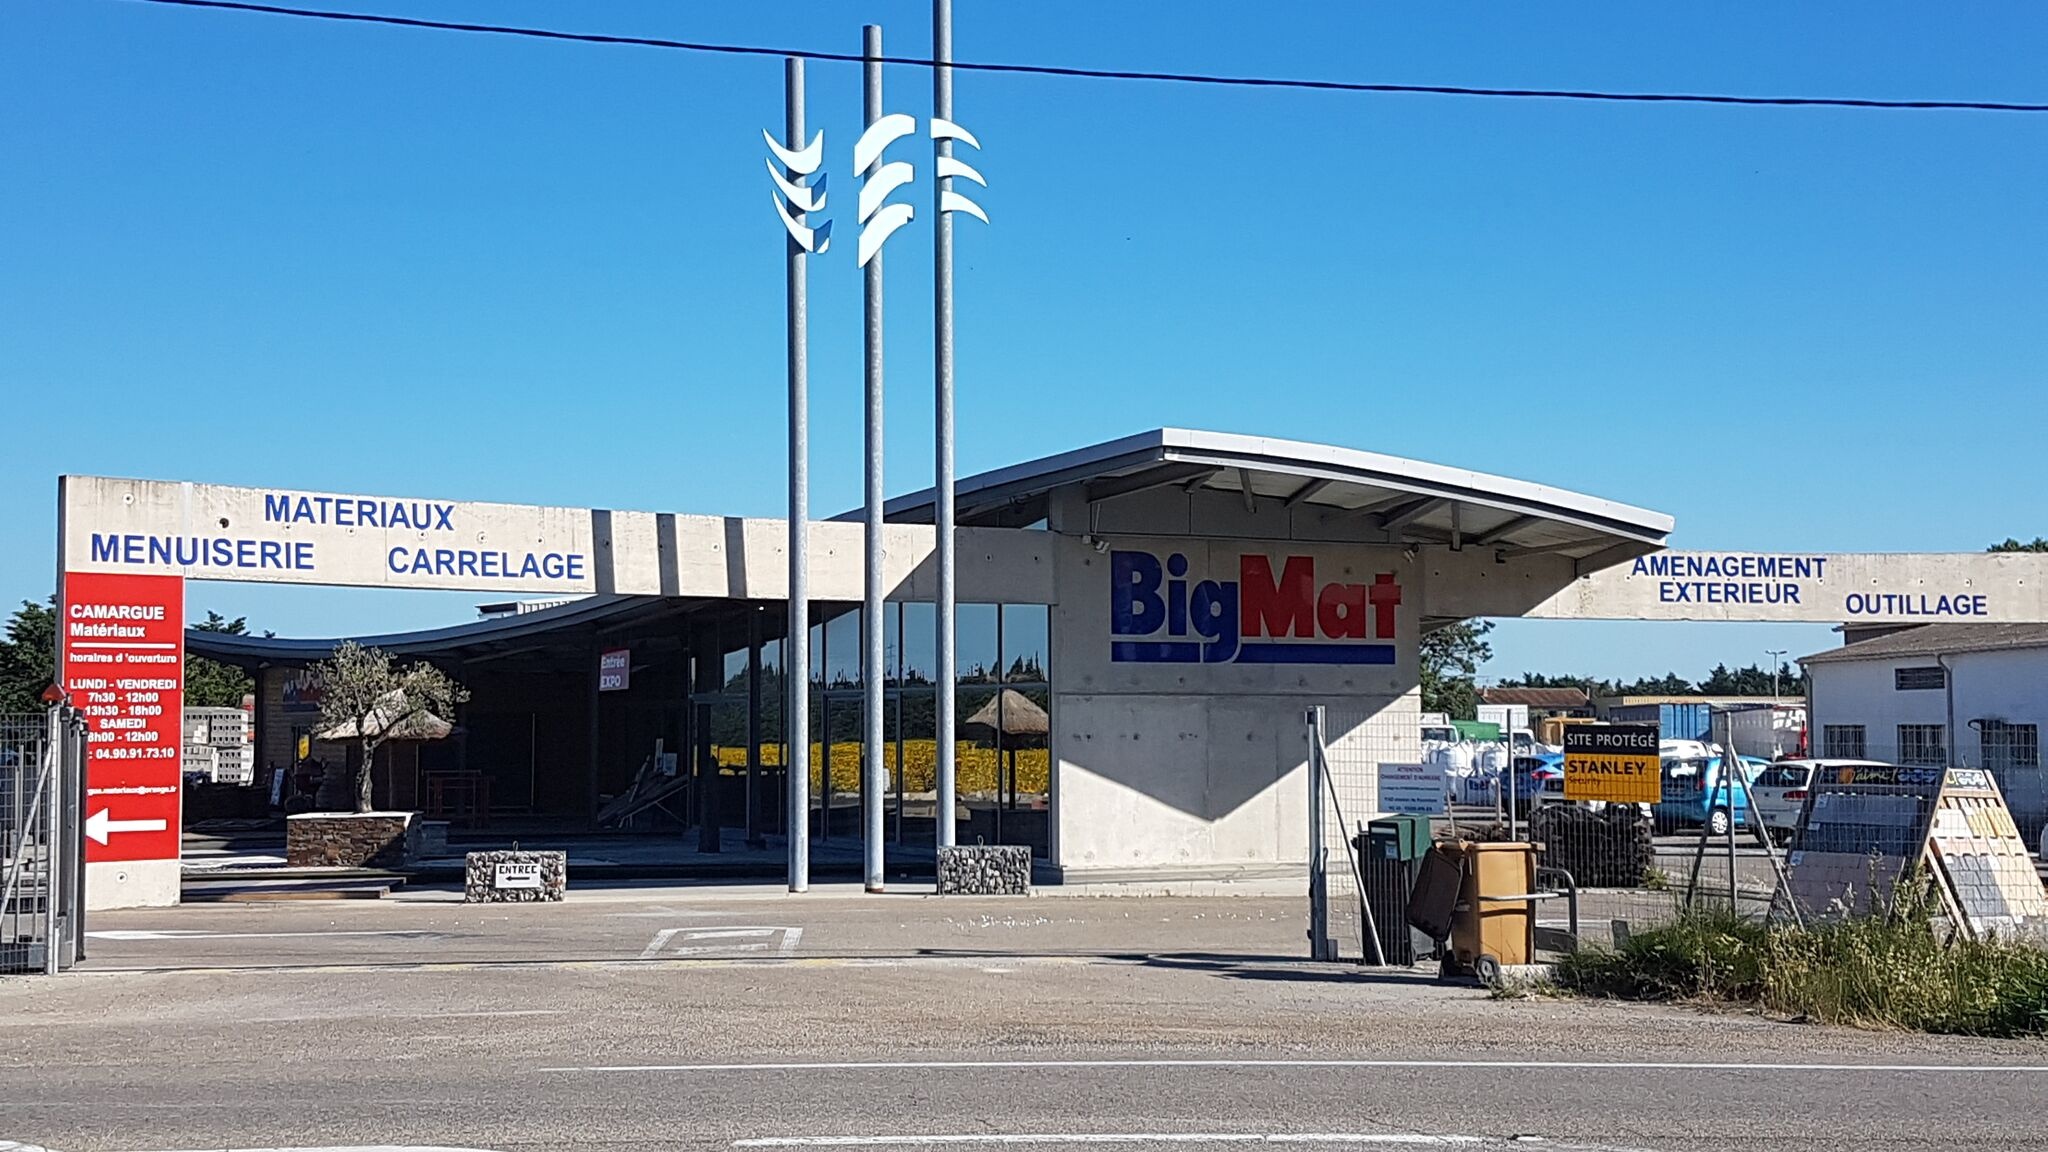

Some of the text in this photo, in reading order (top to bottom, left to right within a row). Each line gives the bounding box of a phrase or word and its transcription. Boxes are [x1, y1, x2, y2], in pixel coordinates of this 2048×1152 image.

[264, 493, 455, 532] MATERIAUX
[91, 532, 315, 570] MENUISERIE
[388, 545, 585, 580] CARRELAGE
[1631, 555, 1827, 580] AMENAGEMENT
[1659, 581, 1800, 605] EXTERIEUR
[70, 604, 165, 620] CAMARGUE
[1845, 592, 1988, 616] OUTILLAGE
[70, 622, 146, 638] Matériaux
[70, 652, 113, 663] horaires
[70, 679, 107, 689] LUNDI
[116, 679, 177, 690] VENDREDI
[87, 692, 116, 703] 7h30
[125, 692, 159, 703] 12h00
[85, 705, 119, 716] 13h30
[128, 705, 162, 716] 18h00
[100, 718, 147, 729] SAMEDI
[87, 731, 115, 743] 8h00
[124, 731, 159, 742] 12h00
[1567, 731, 1656, 748] SITE PROTÉGÉ
[95, 747, 175, 760] 04.90.91.73.10
[1568, 760, 1646, 776] STANLEY
[498, 865, 538, 875] ENTREE
